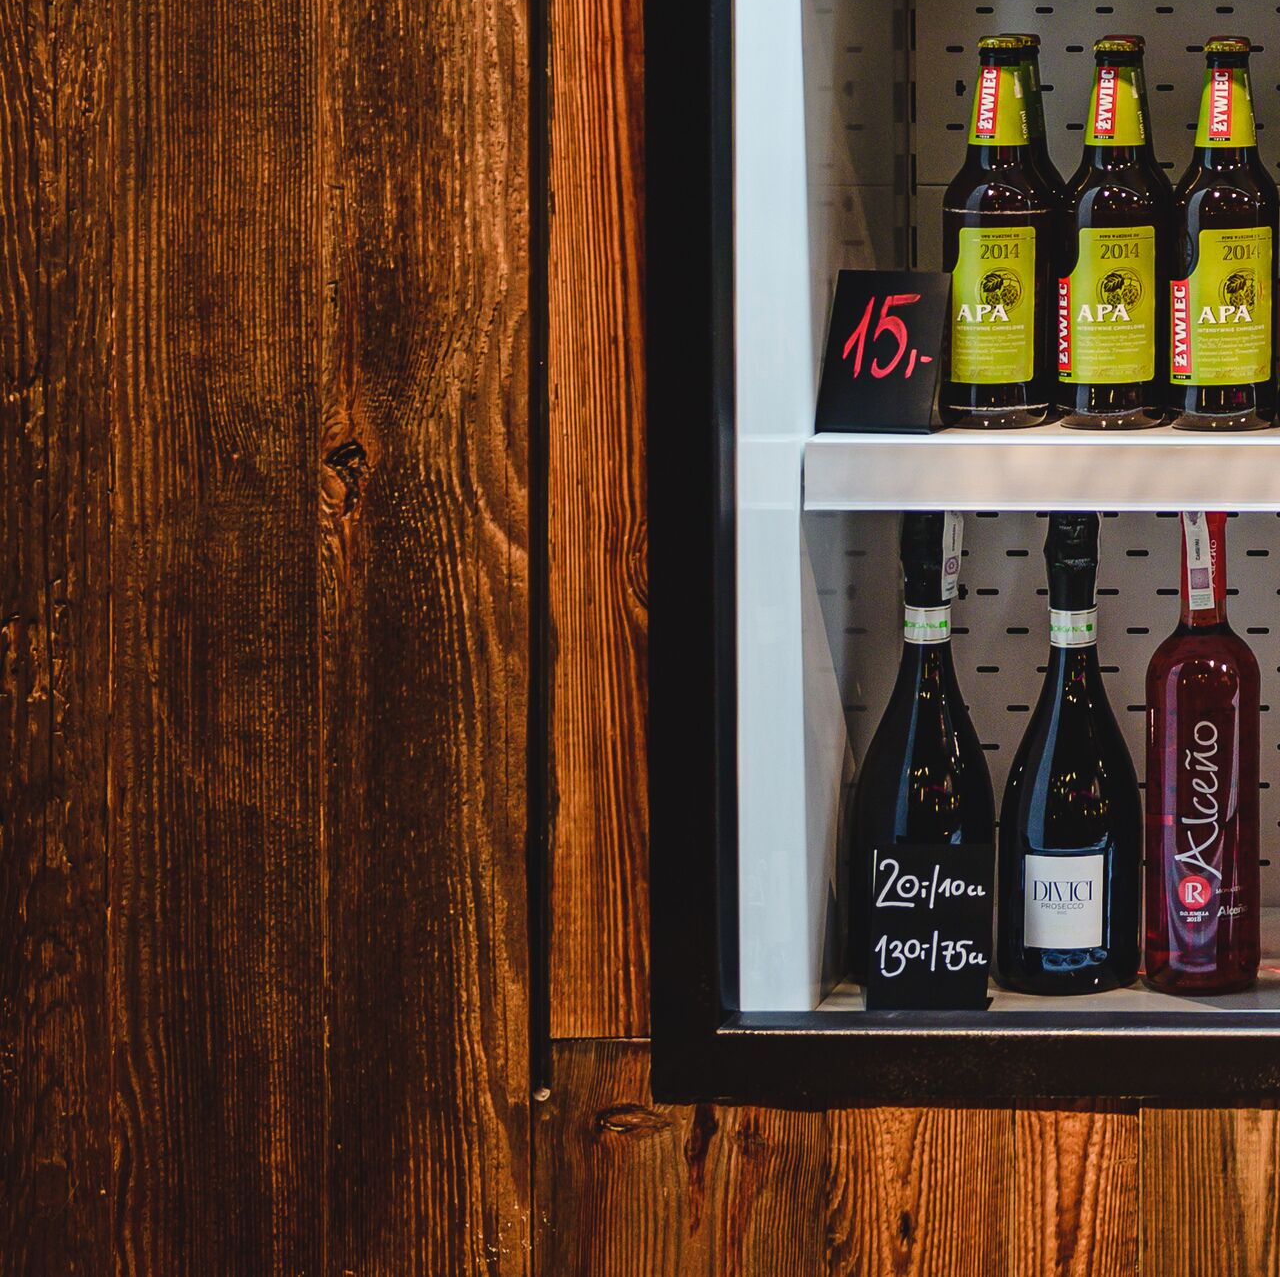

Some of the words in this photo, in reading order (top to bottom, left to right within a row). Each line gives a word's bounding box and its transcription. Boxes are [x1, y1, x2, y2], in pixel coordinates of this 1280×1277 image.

[978, 68, 997, 129] ŻYWIEC
[1100, 243, 1139, 259] 2014
[1077, 304, 1131, 323] APA
[1173, 283, 1187, 368] ŻYWIEC
[1032, 880, 1093, 901] DIVICI
[1040, 902, 1085, 910] PROSECCO
